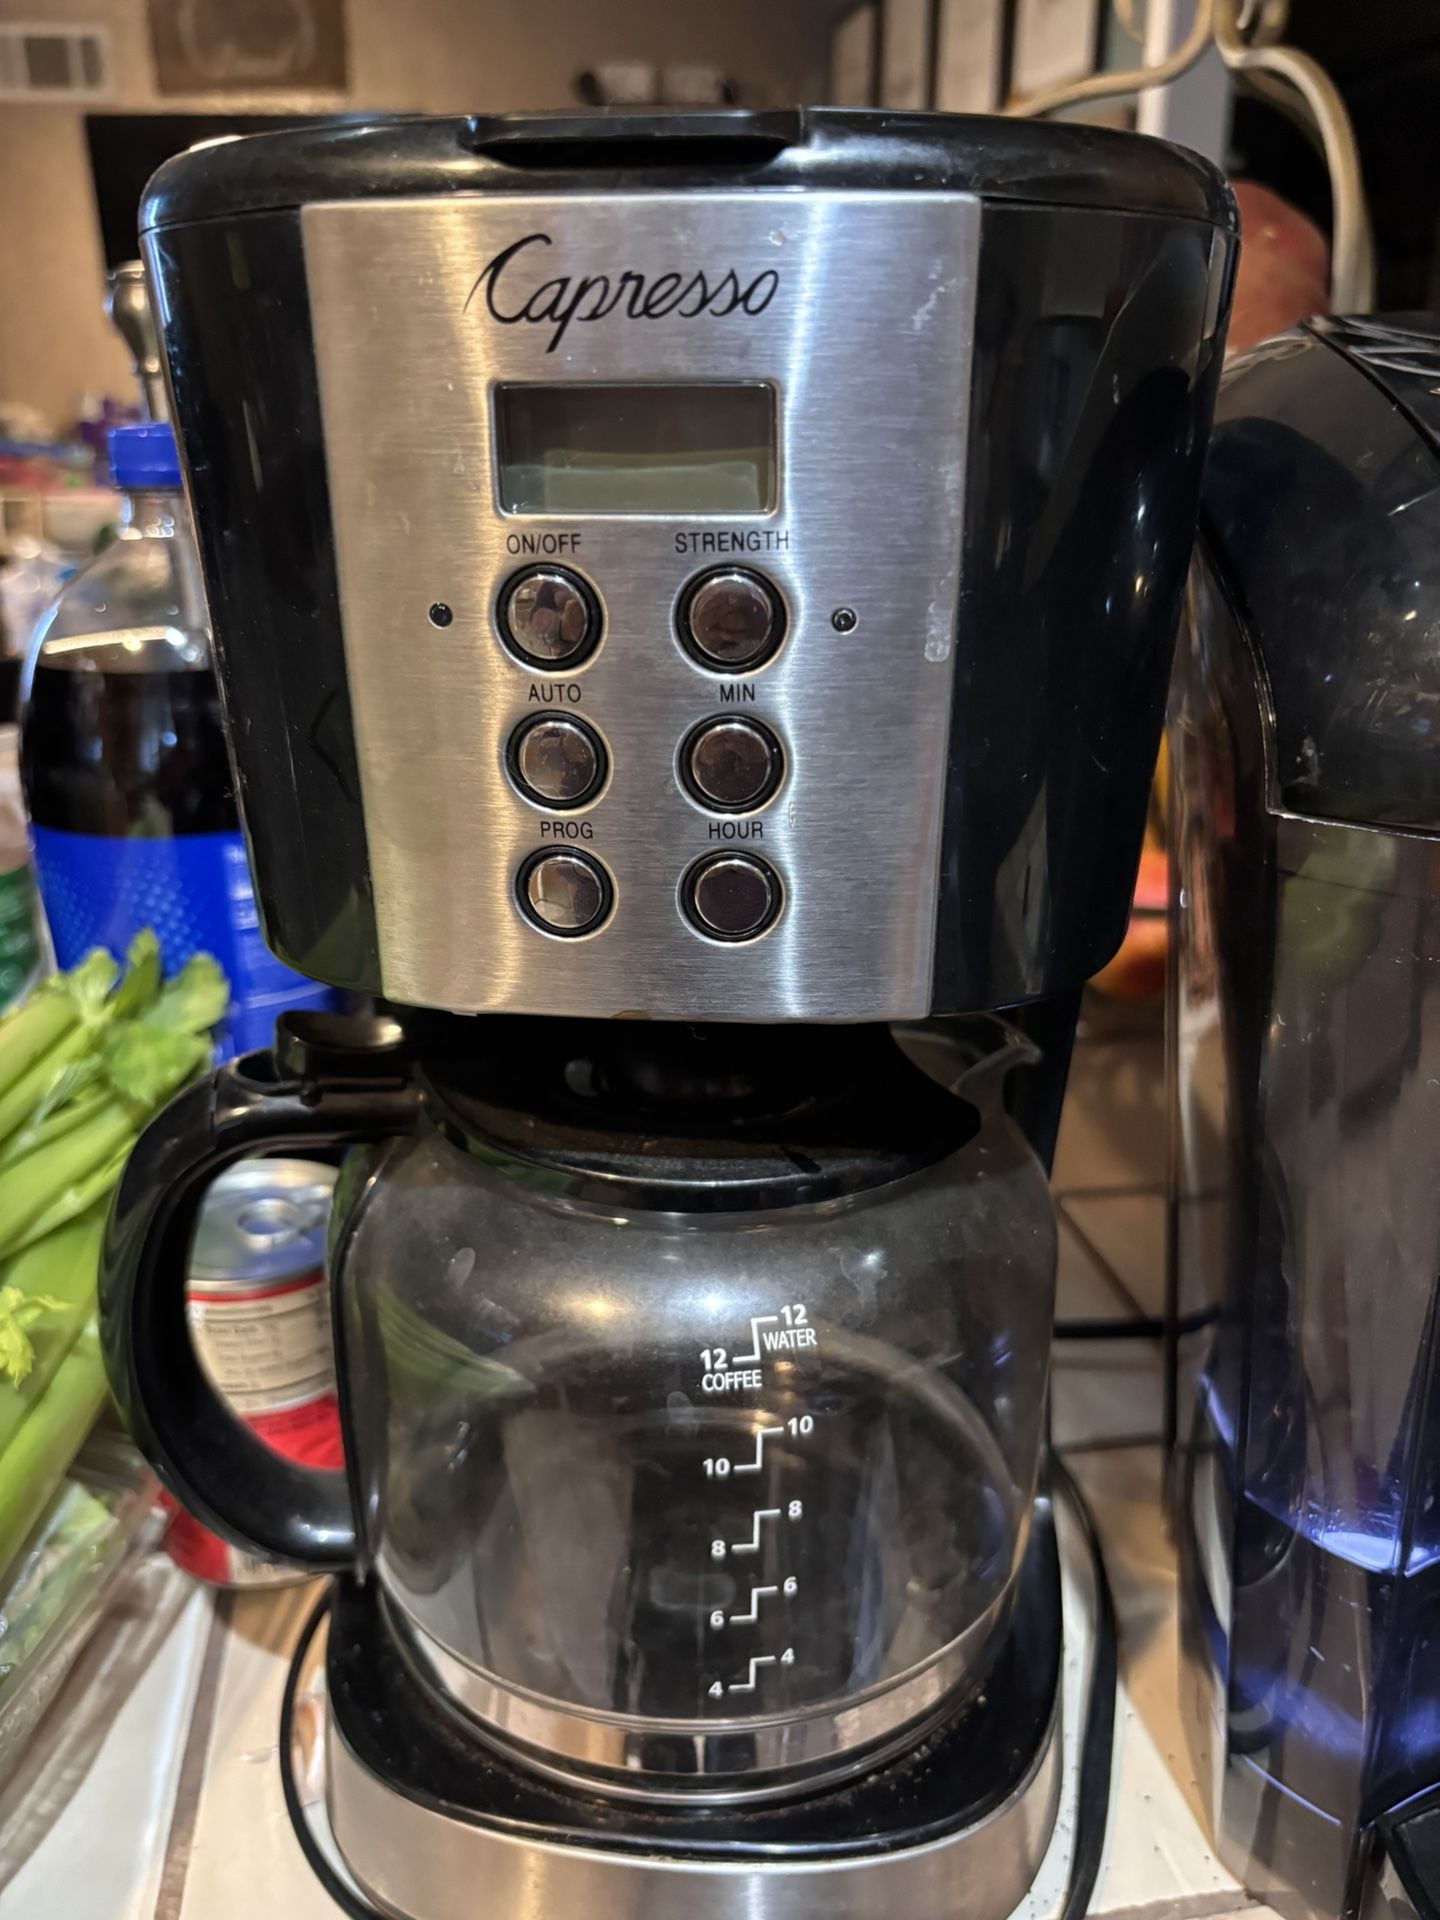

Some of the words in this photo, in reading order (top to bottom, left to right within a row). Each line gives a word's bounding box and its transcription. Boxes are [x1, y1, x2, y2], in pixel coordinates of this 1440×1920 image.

[463, 233, 779, 353] Capresso
[506, 533, 582, 554] ON/OFF
[675, 531, 789, 553] STRENGTH
[528, 684, 581, 702] AUTO
[720, 684, 755, 702] MIN
[540, 821, 594, 839] PROG
[708, 822, 763, 839] HOUR
[780, 1304, 808, 1326] 12
[763, 1328, 817, 1350] WATER
[700, 1348, 728, 1370] 12
[702, 1369, 762, 1391] COFFEE
[787, 1415, 814, 1436] 10
[702, 1458, 730, 1477] 10
[788, 1500, 802, 1519] 8
[711, 1539, 726, 1559] 8
[783, 1576, 798, 1596] 6
[710, 1610, 725, 1629] 6
[780, 1648, 795, 1665] 4
[708, 1681, 723, 1698] 4
